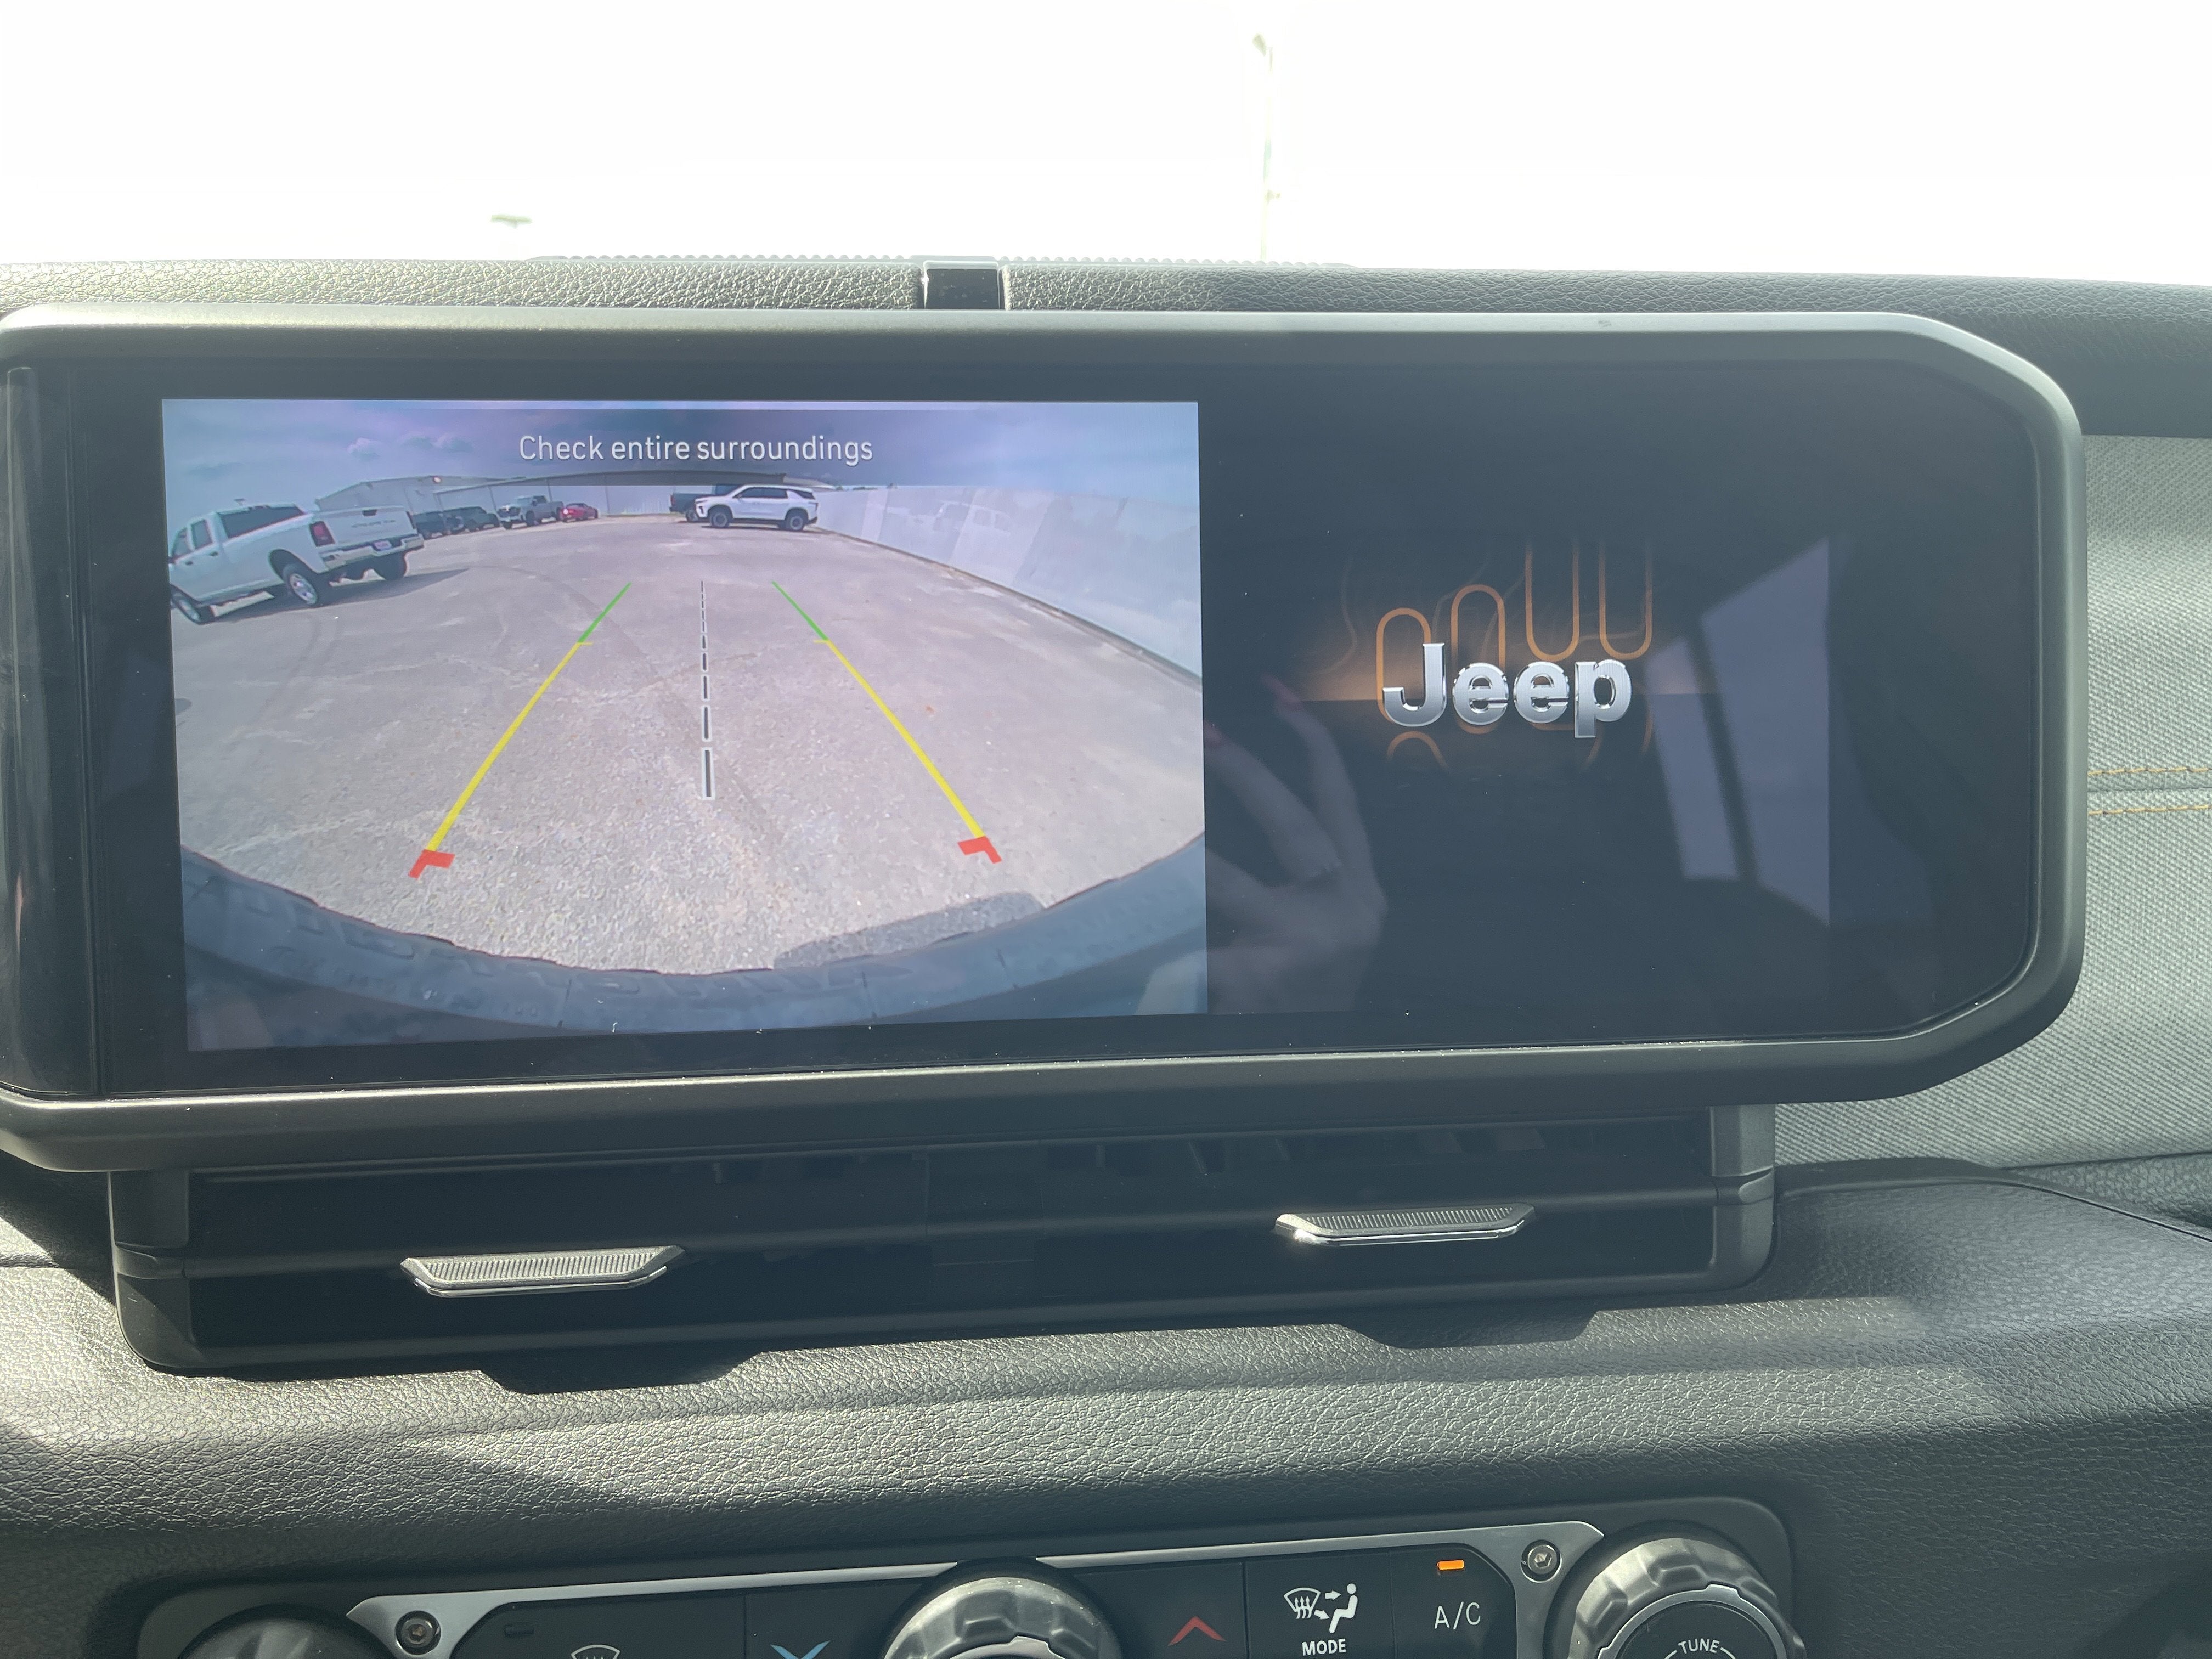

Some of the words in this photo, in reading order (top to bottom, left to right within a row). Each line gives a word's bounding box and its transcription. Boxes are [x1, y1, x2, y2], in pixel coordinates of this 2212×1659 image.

[519, 435, 604, 460] Check
[612, 435, 690, 460] entire
[697, 435, 873, 466] surroundings
[1382, 642, 1632, 738] Jeep
[1434, 1601, 1481, 1630] A/C
[1302, 1638, 1347, 1656] MODE
[1678, 1638, 1720, 1655] TUNE
